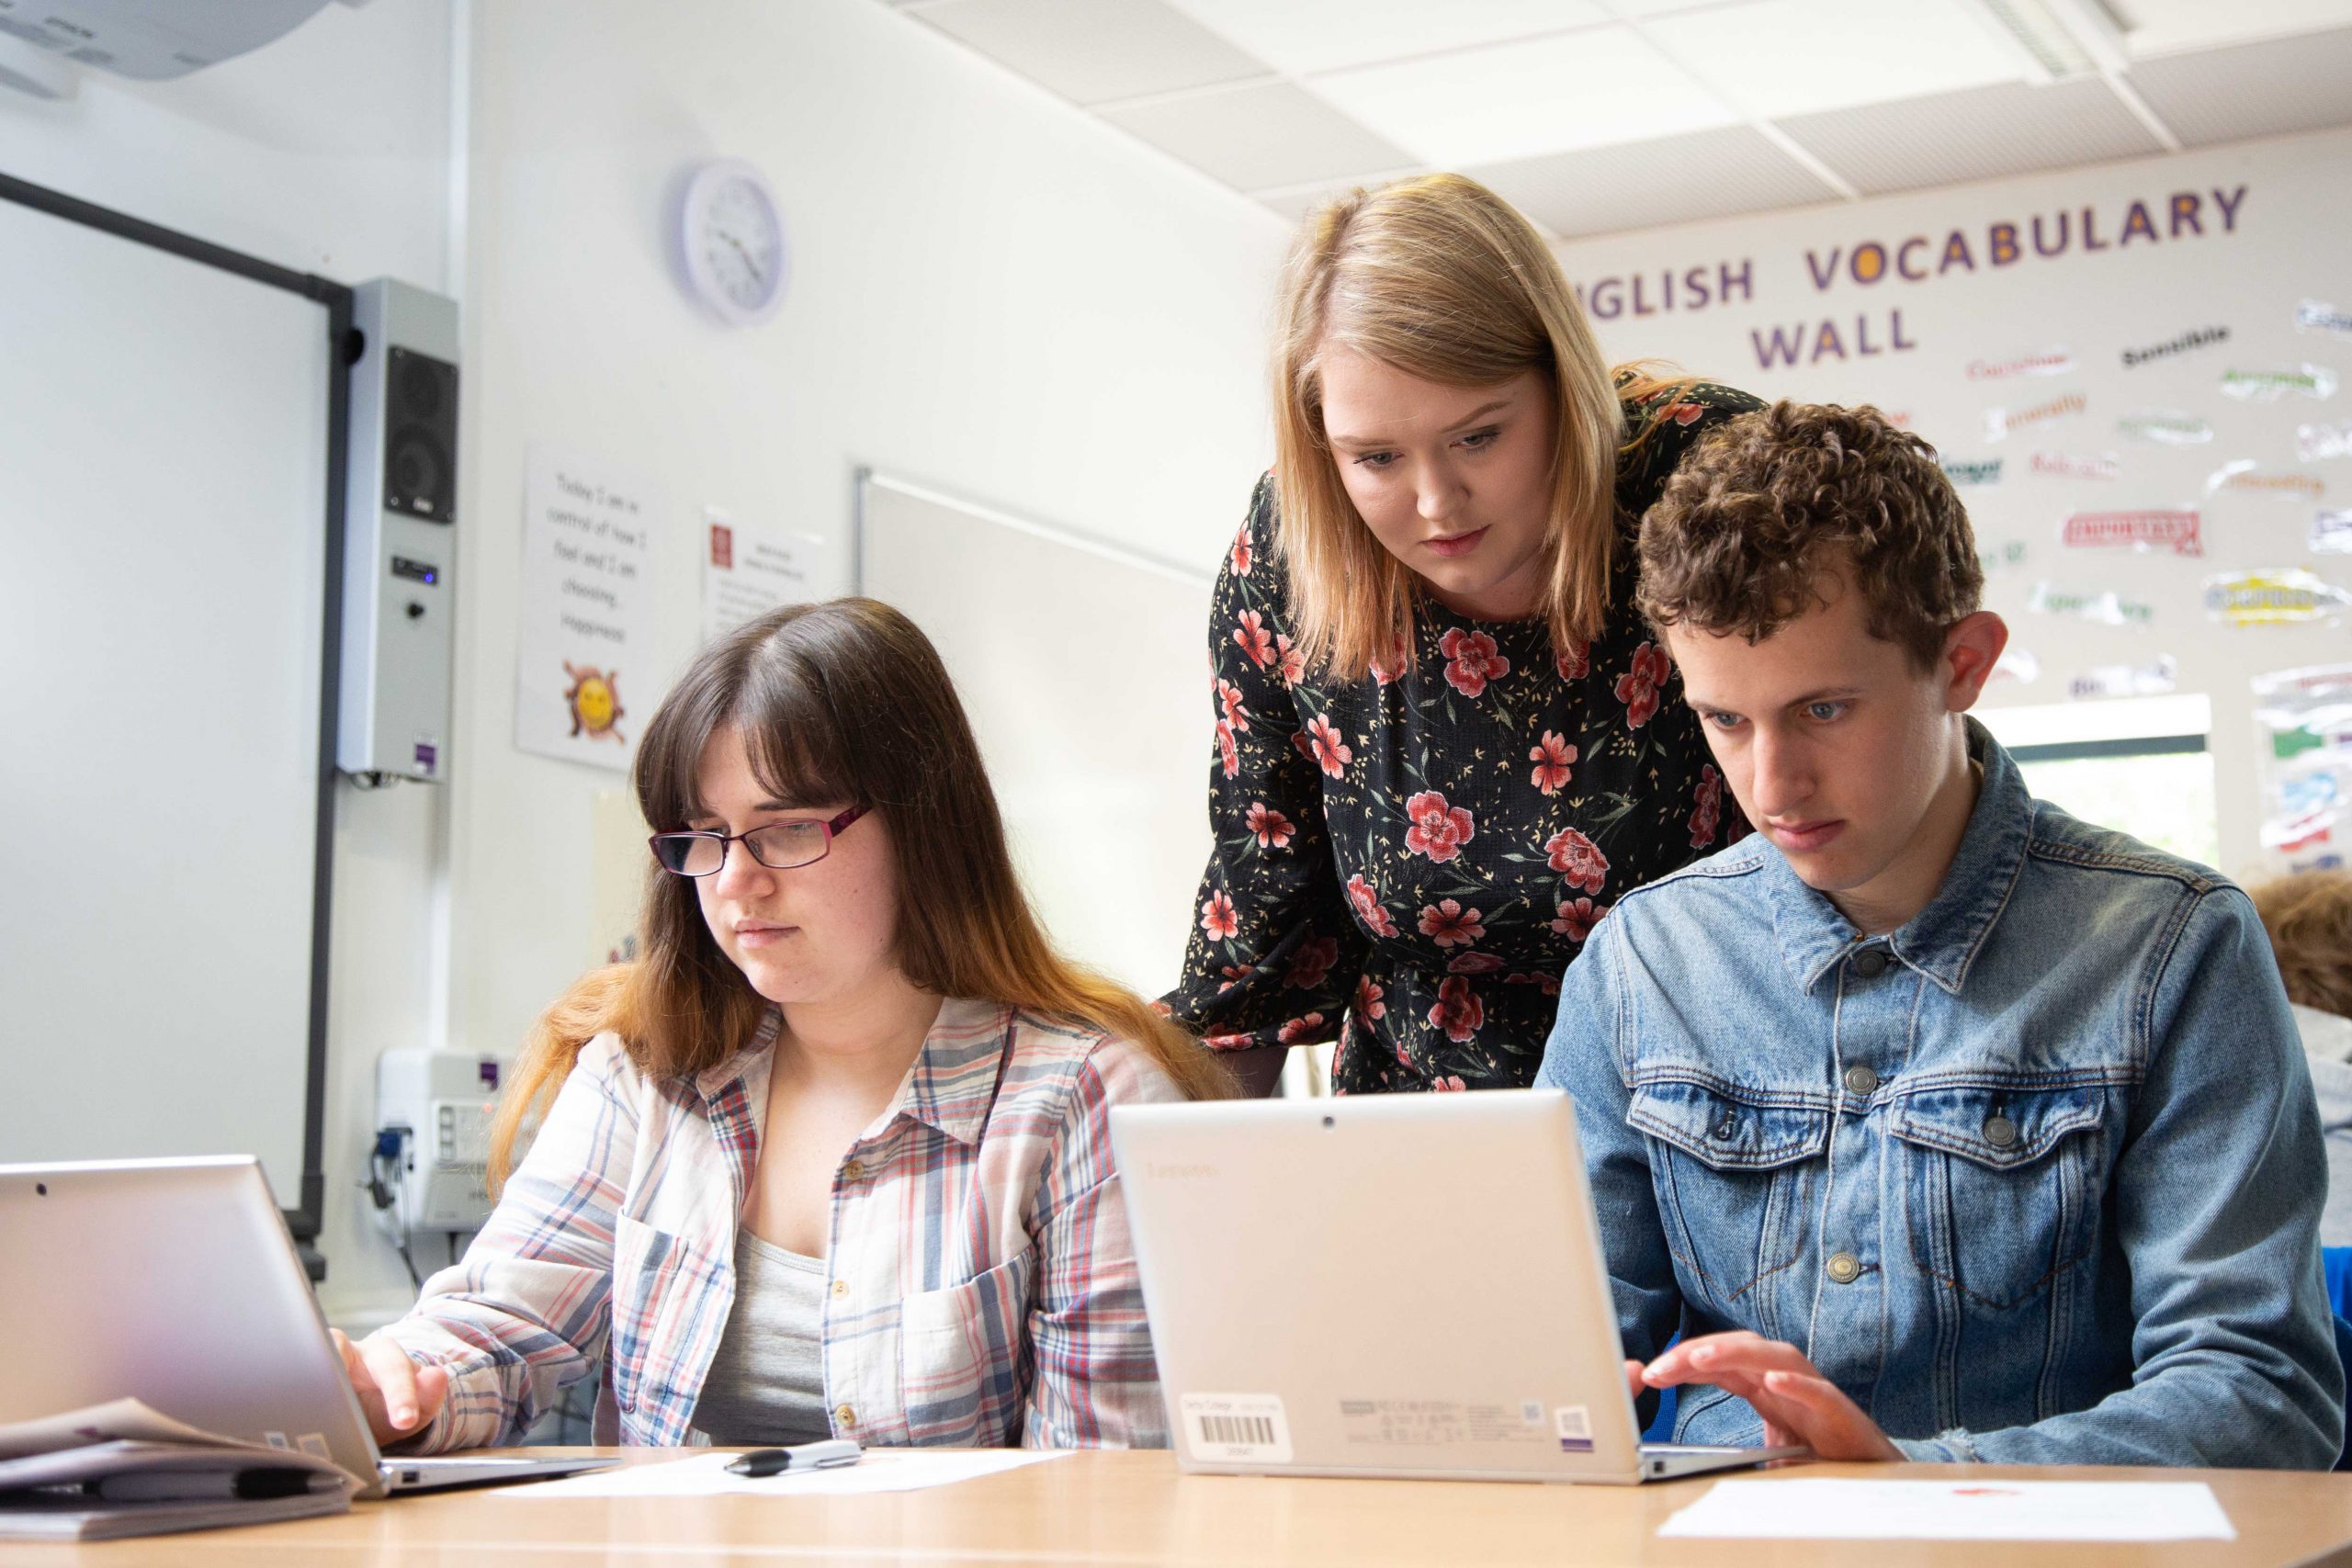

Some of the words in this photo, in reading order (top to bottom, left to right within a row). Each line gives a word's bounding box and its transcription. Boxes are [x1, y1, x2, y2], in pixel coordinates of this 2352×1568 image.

[1577, 257, 1754, 320] GLISH
[1804, 184, 2247, 292] VOCABULARY
[1750, 308, 1917, 369] WALL
[2120, 326, 2231, 368] Sensible
[547, 507, 591, 533] control
